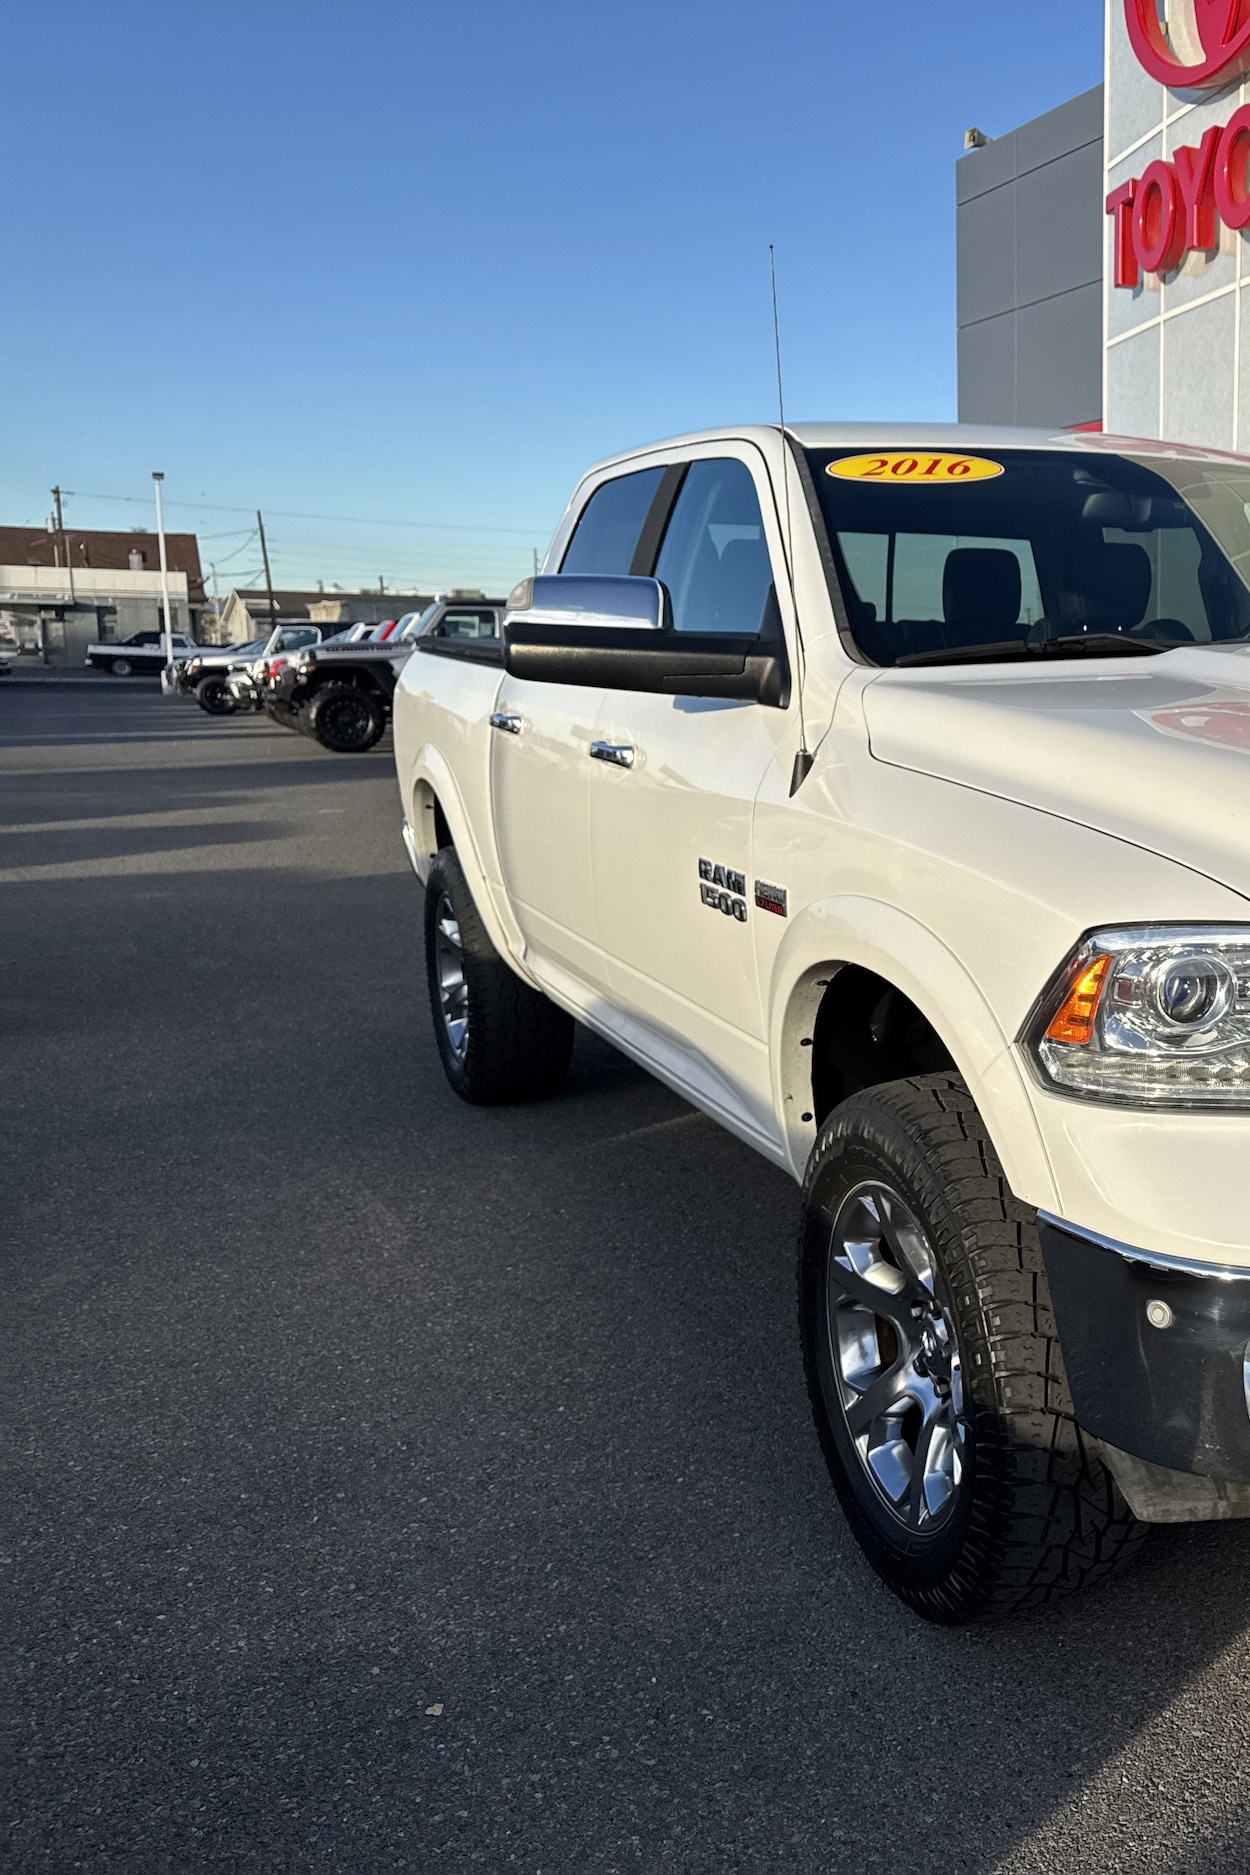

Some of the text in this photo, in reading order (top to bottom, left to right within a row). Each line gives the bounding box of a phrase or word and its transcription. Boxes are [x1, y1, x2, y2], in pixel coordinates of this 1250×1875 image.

[860, 458, 975, 477] 2016
[698, 856, 746, 897] RAM
[700, 882, 748, 922] 1500
